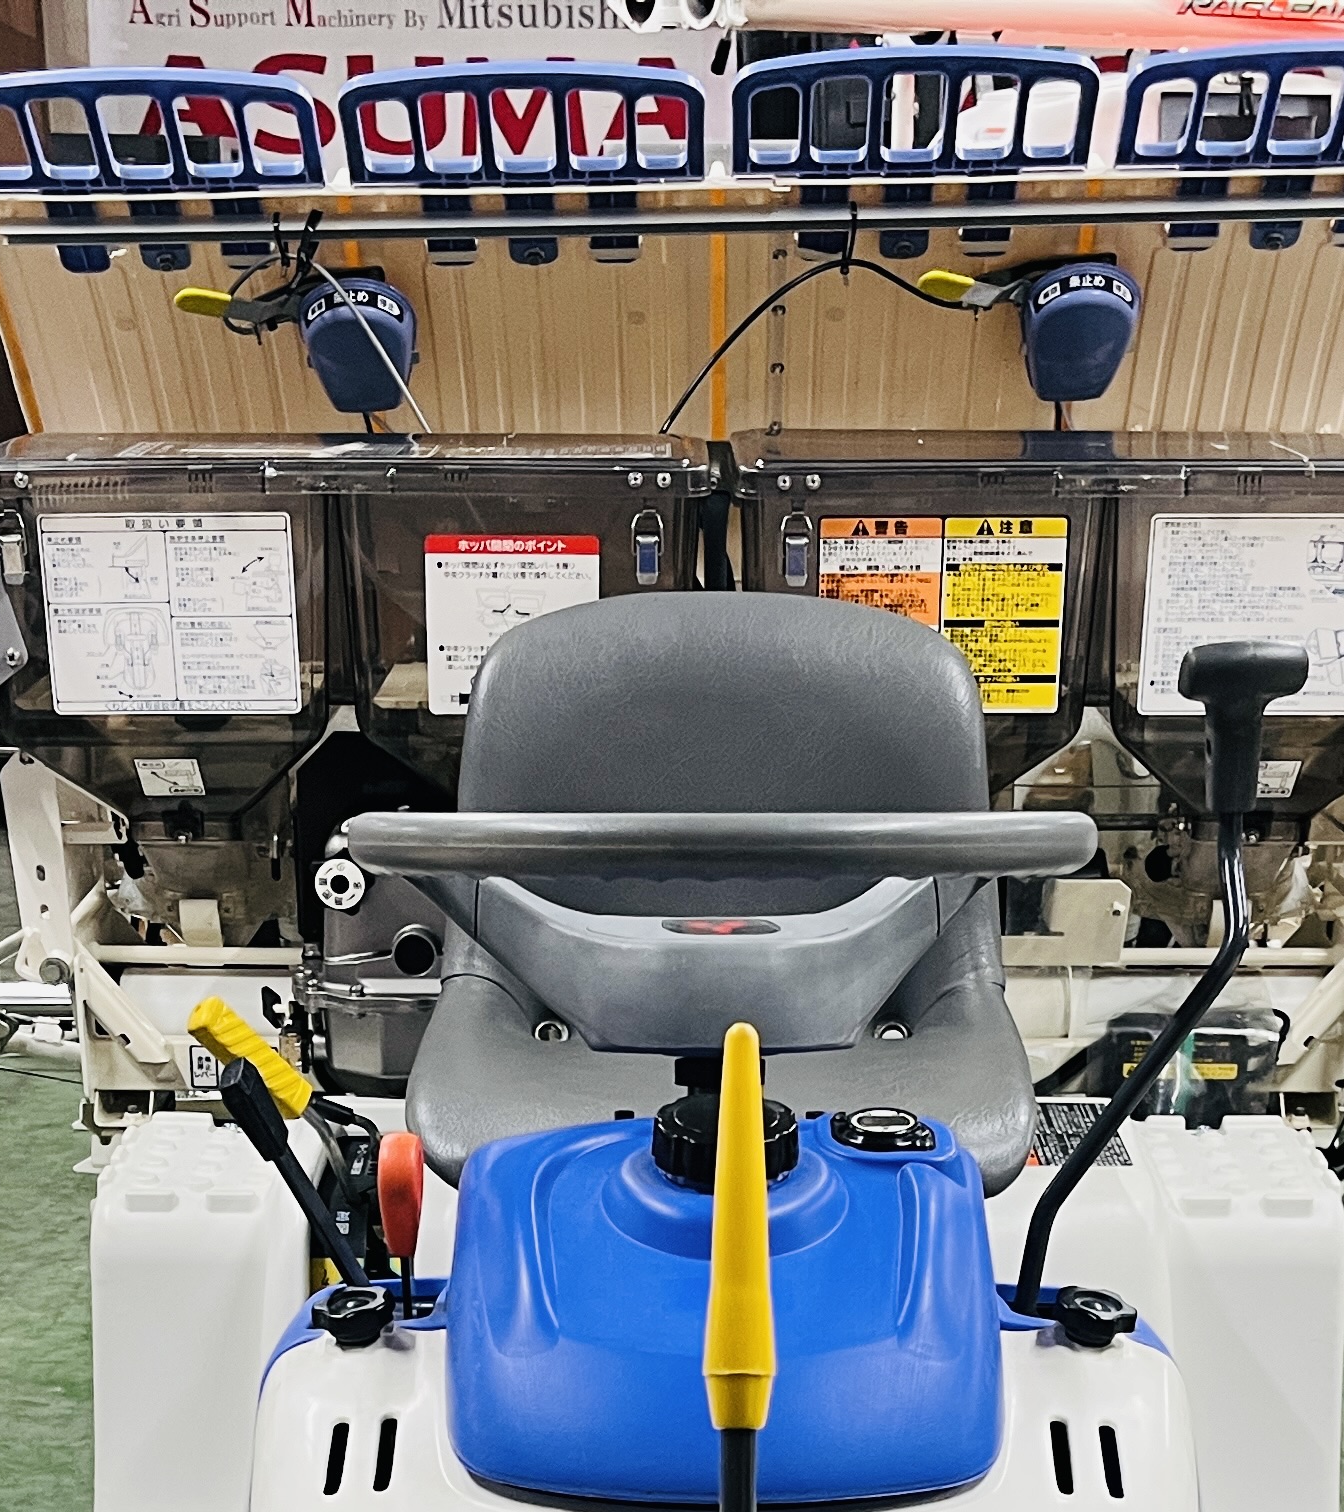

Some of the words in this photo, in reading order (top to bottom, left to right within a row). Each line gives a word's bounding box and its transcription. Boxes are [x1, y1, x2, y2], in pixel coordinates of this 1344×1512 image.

[128, 0, 182, 28] Agri
[190, 0, 277, 30] Support
[285, 0, 395, 30] Machinery
[404, 10, 428, 30] By
[436, 0, 630, 30] Mitsubish
